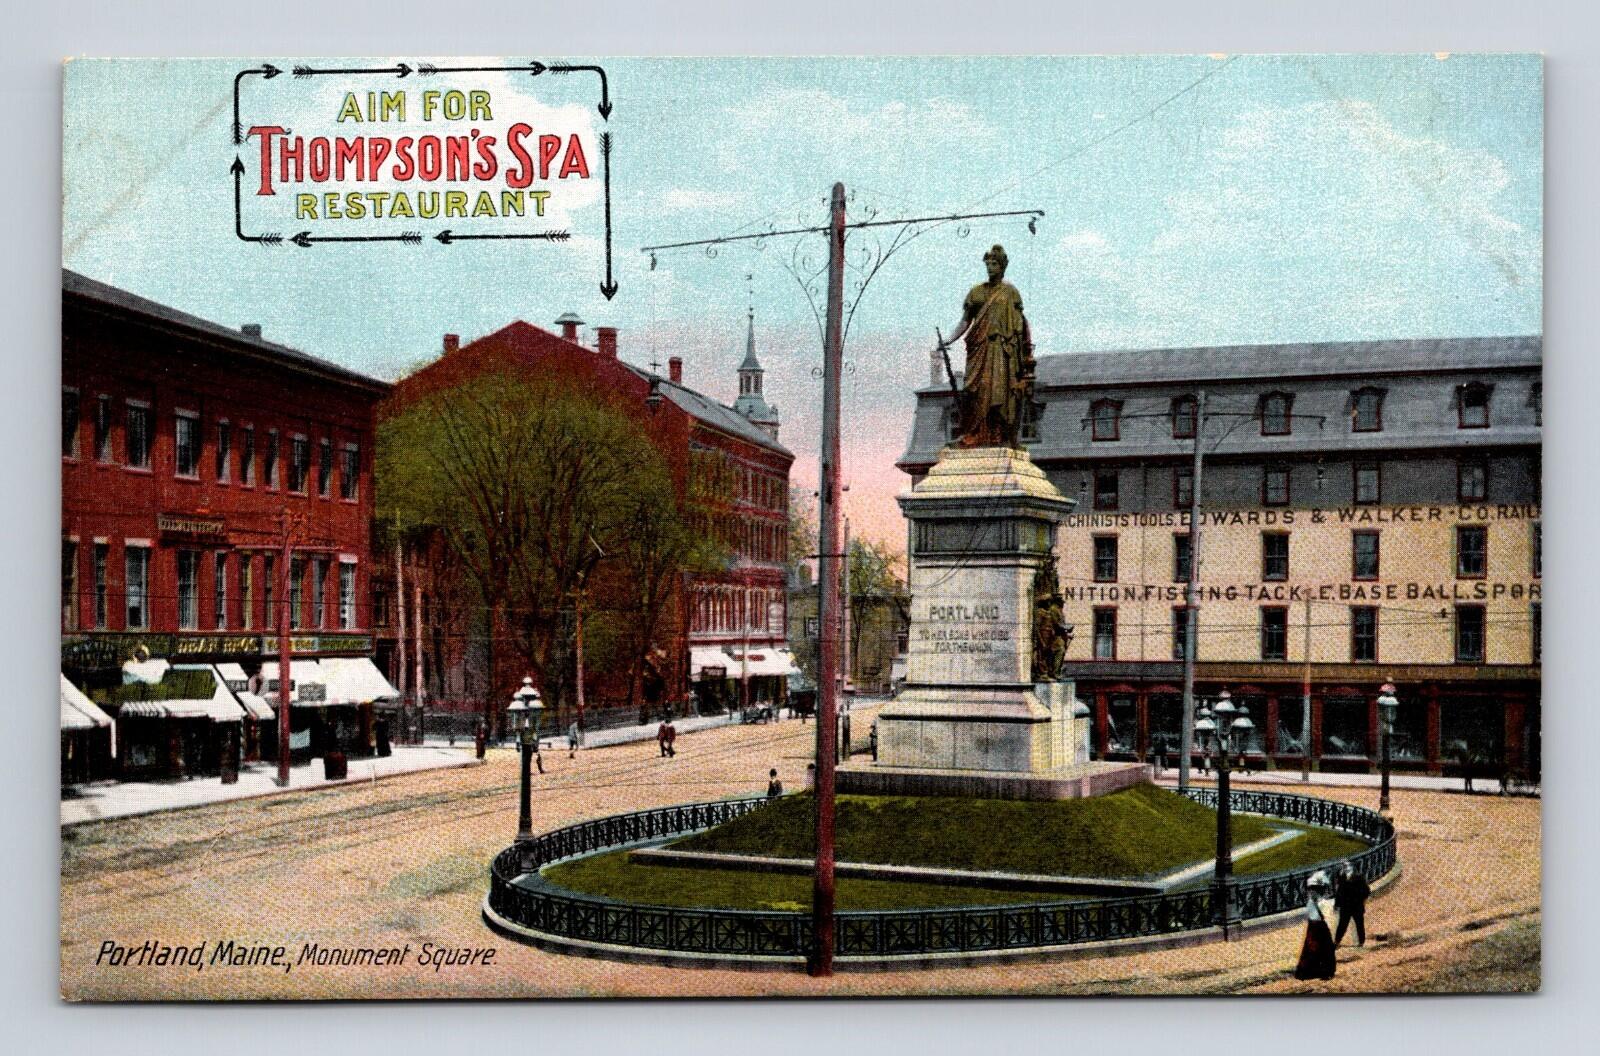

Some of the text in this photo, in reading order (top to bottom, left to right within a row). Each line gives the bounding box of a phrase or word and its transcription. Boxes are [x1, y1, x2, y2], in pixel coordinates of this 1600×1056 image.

[1311, 508, 1327, 524] &
[1338, 507, 1443, 523] WALKER
[1339, 584, 1399, 600] BASE
[929, 604, 999, 620] PORTLAND
